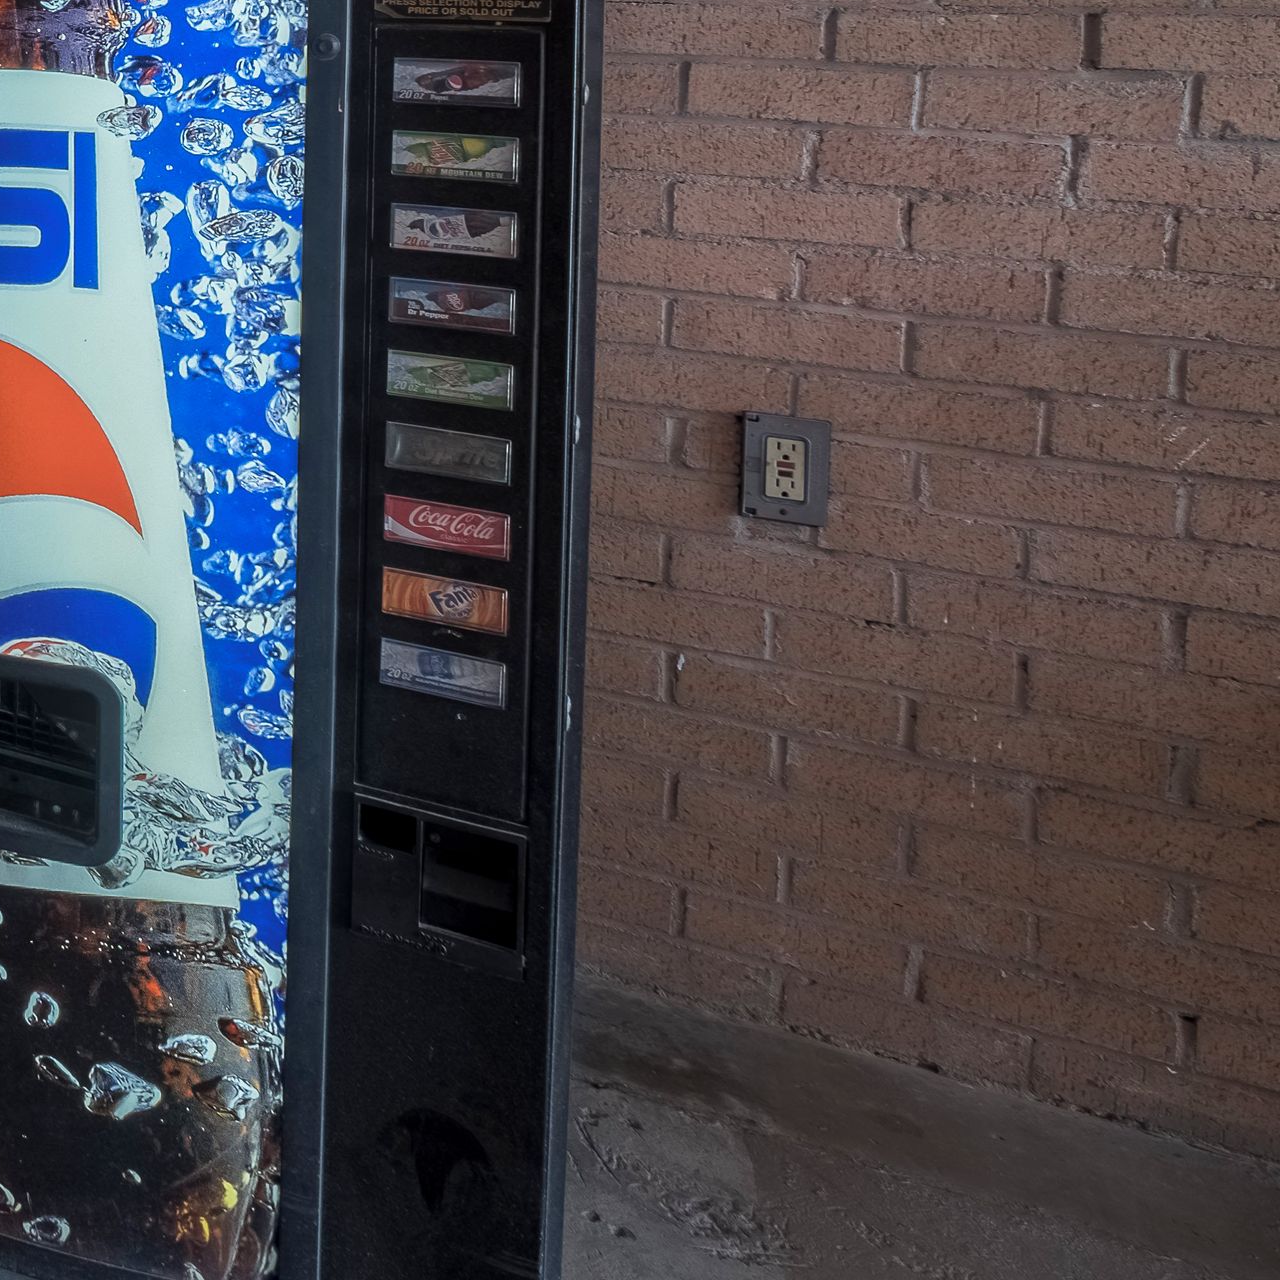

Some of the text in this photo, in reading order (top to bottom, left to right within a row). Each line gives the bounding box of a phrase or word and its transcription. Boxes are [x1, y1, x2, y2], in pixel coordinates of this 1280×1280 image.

[479, 0, 493, 7] TO
[496, 0, 541, 9] DISPLAY
[407, 6, 514, 17] PRICE OR SOLD OUT
[399, 89, 412, 99] 20
[440, 168, 482, 178] MOUNTAIN
[485, 171, 503, 179] DEW
[404, 236, 418, 247] 20
[419, 310, 449, 319] Pepper
[393, 380, 407, 390] 20
[409, 505, 497, 540] Coca-Cola
[428, 585, 479, 616] Fanta
[387, 668, 401, 678] 20
